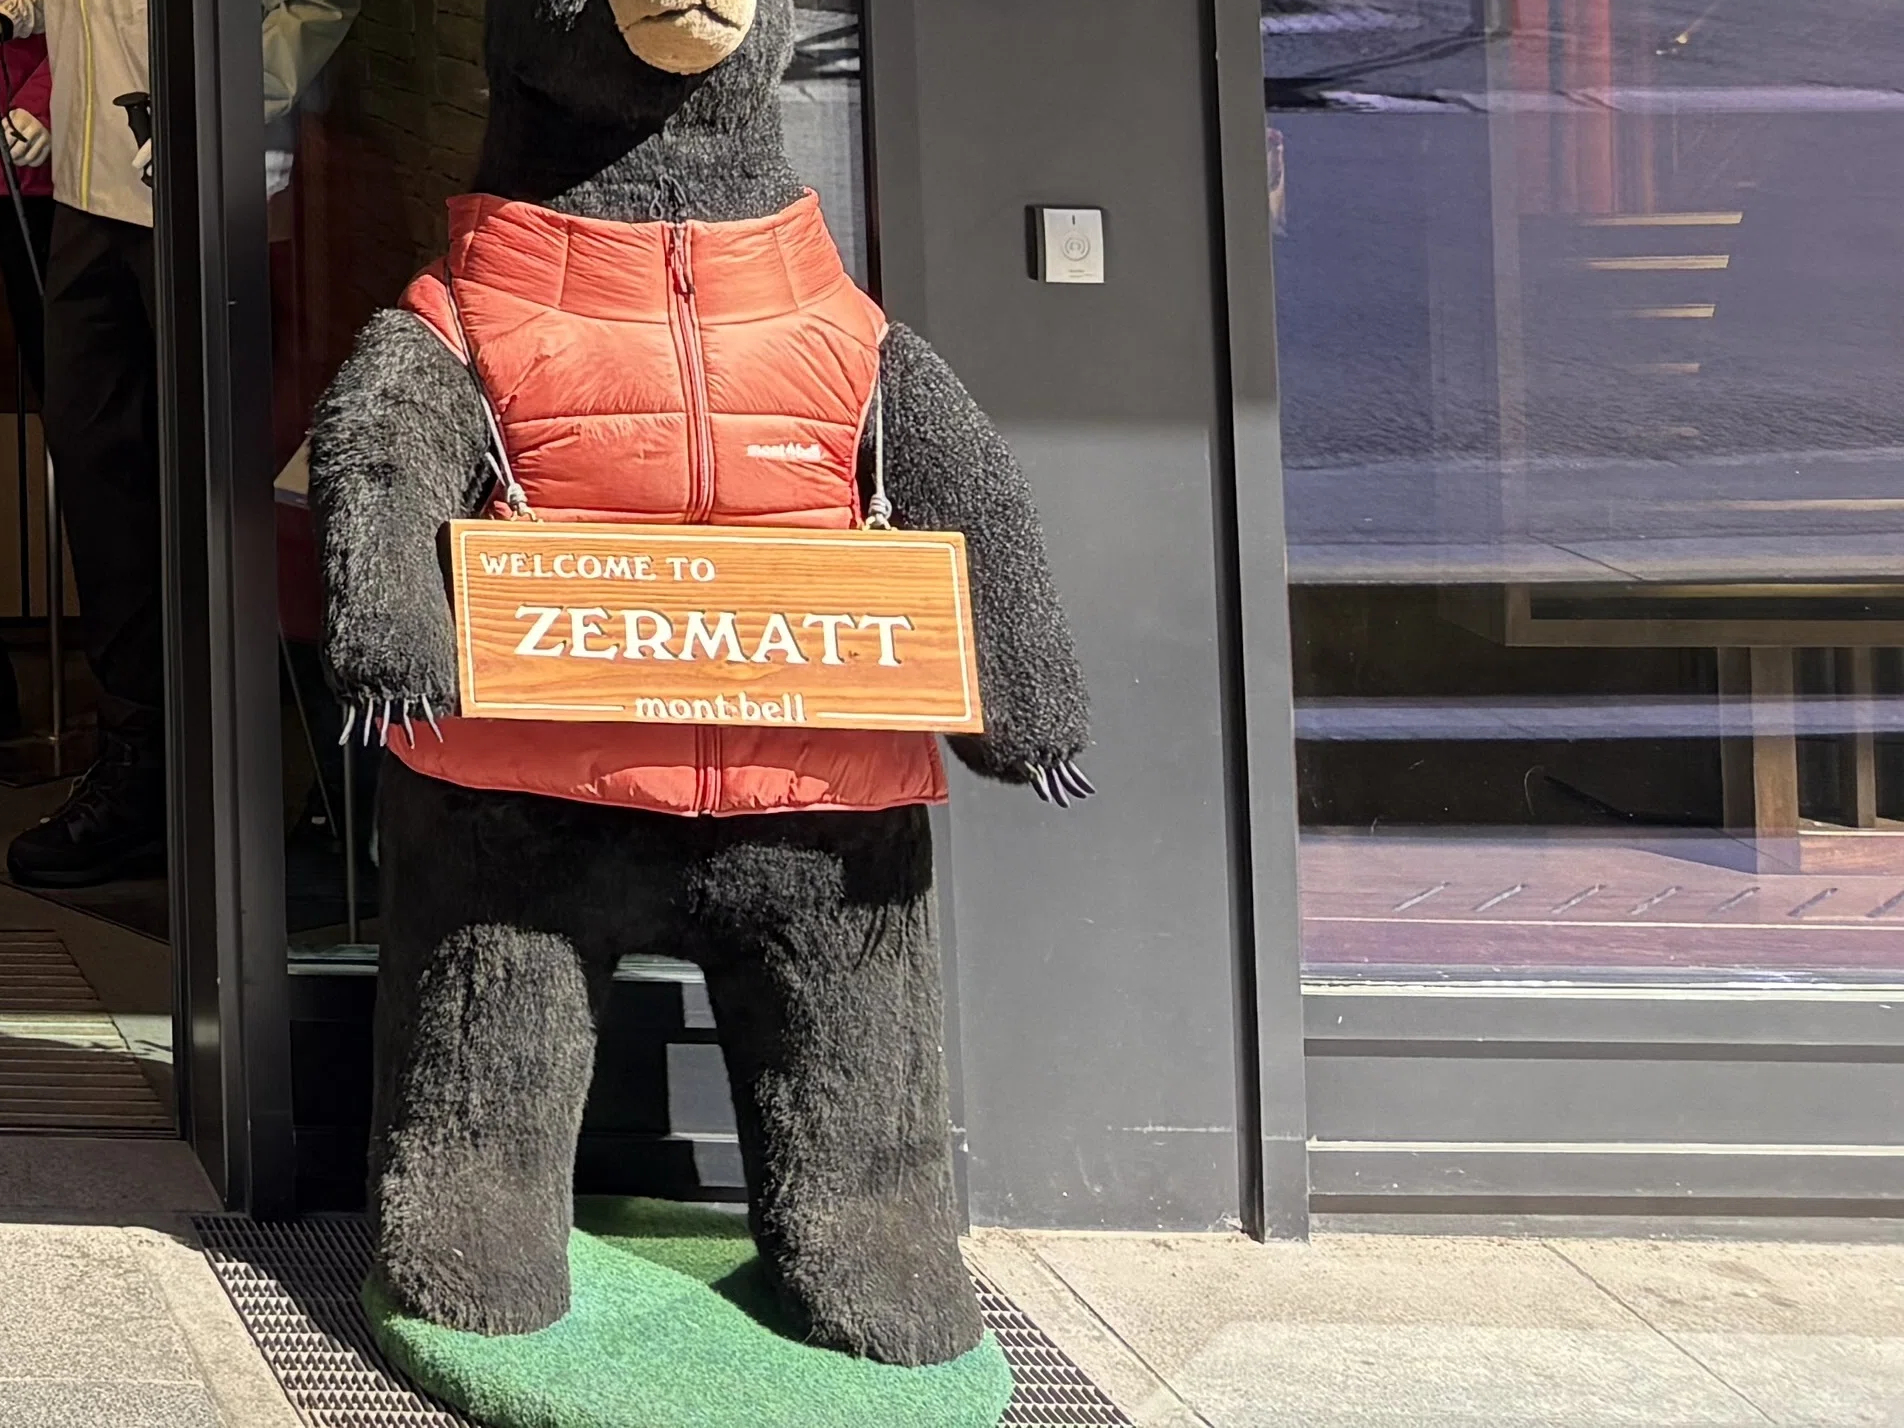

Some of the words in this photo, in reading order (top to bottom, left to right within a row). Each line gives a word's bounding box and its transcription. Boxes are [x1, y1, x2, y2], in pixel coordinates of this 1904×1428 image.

[480, 551, 657, 582] WELCOME
[666, 555, 716, 583] TO
[512, 603, 916, 668] ZERMATT
